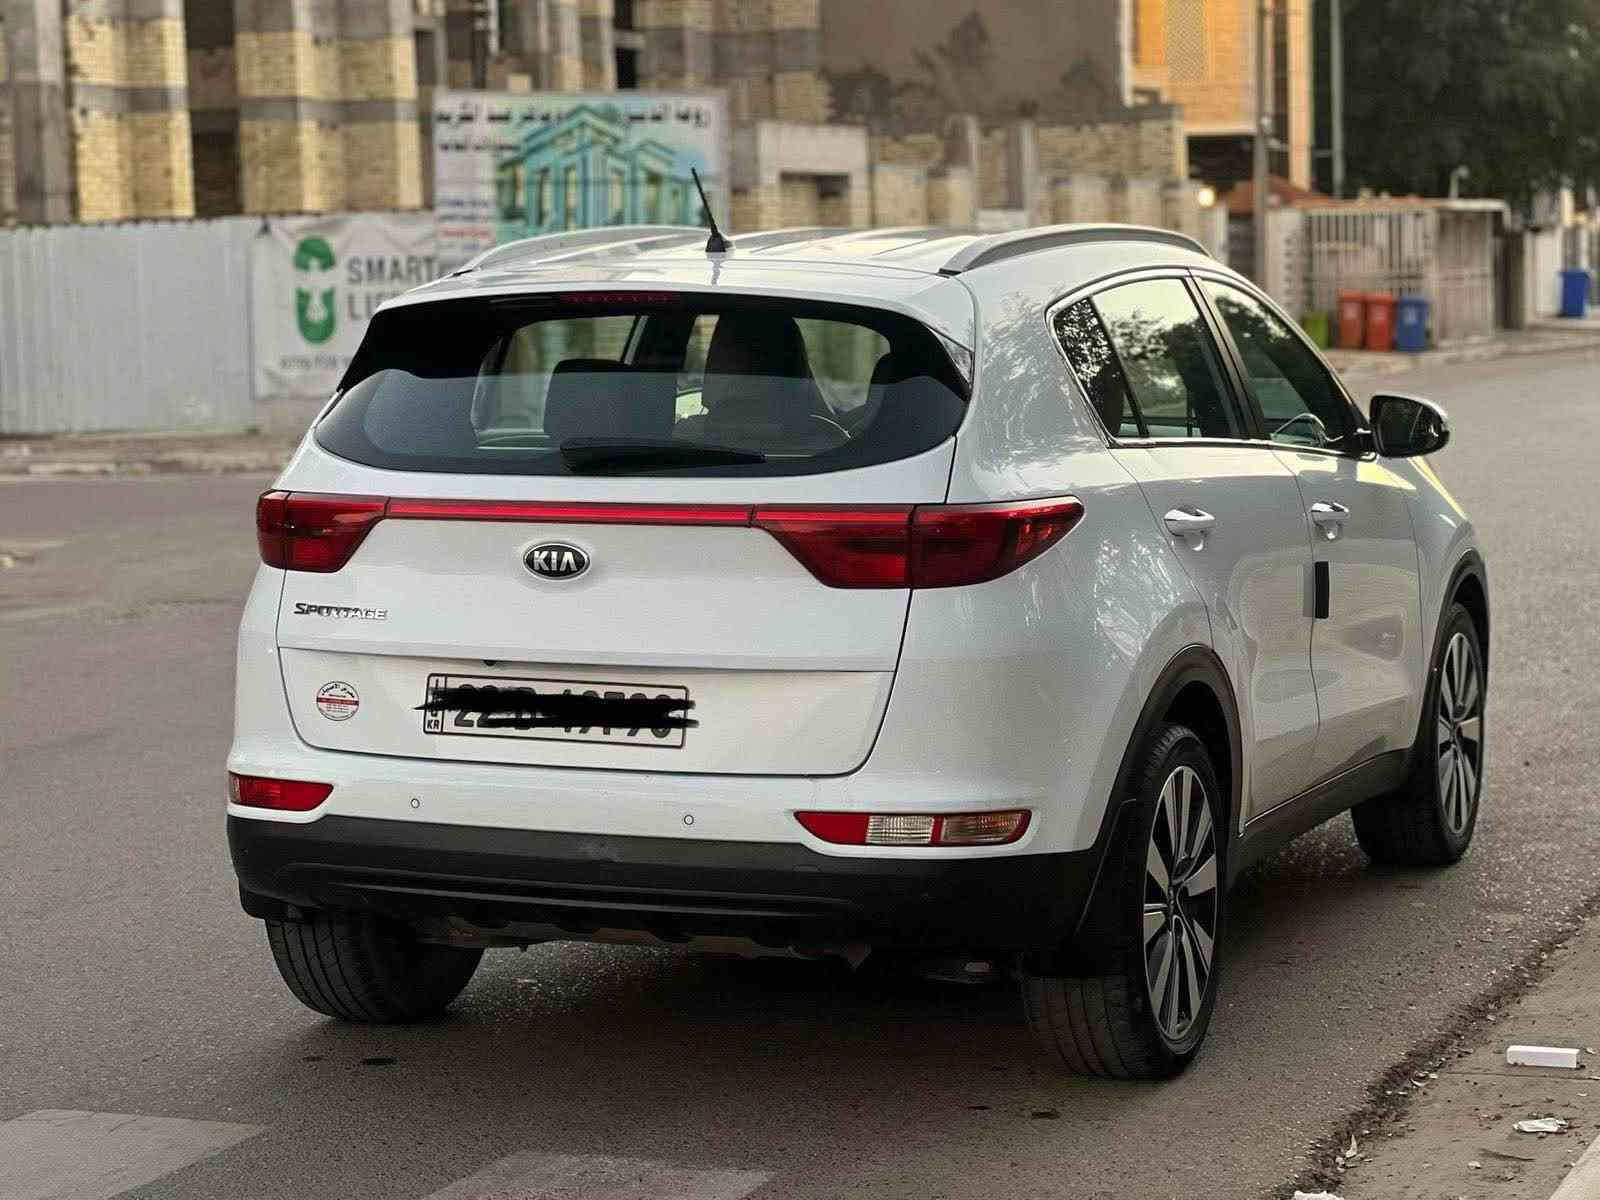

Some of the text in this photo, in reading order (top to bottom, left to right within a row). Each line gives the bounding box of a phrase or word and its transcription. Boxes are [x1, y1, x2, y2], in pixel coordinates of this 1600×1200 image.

[347, 255, 434, 284] SMART
[533, 550, 578, 571] KIA
[293, 602, 388, 620] SPORTAGE
[426, 719, 440, 730] KR
